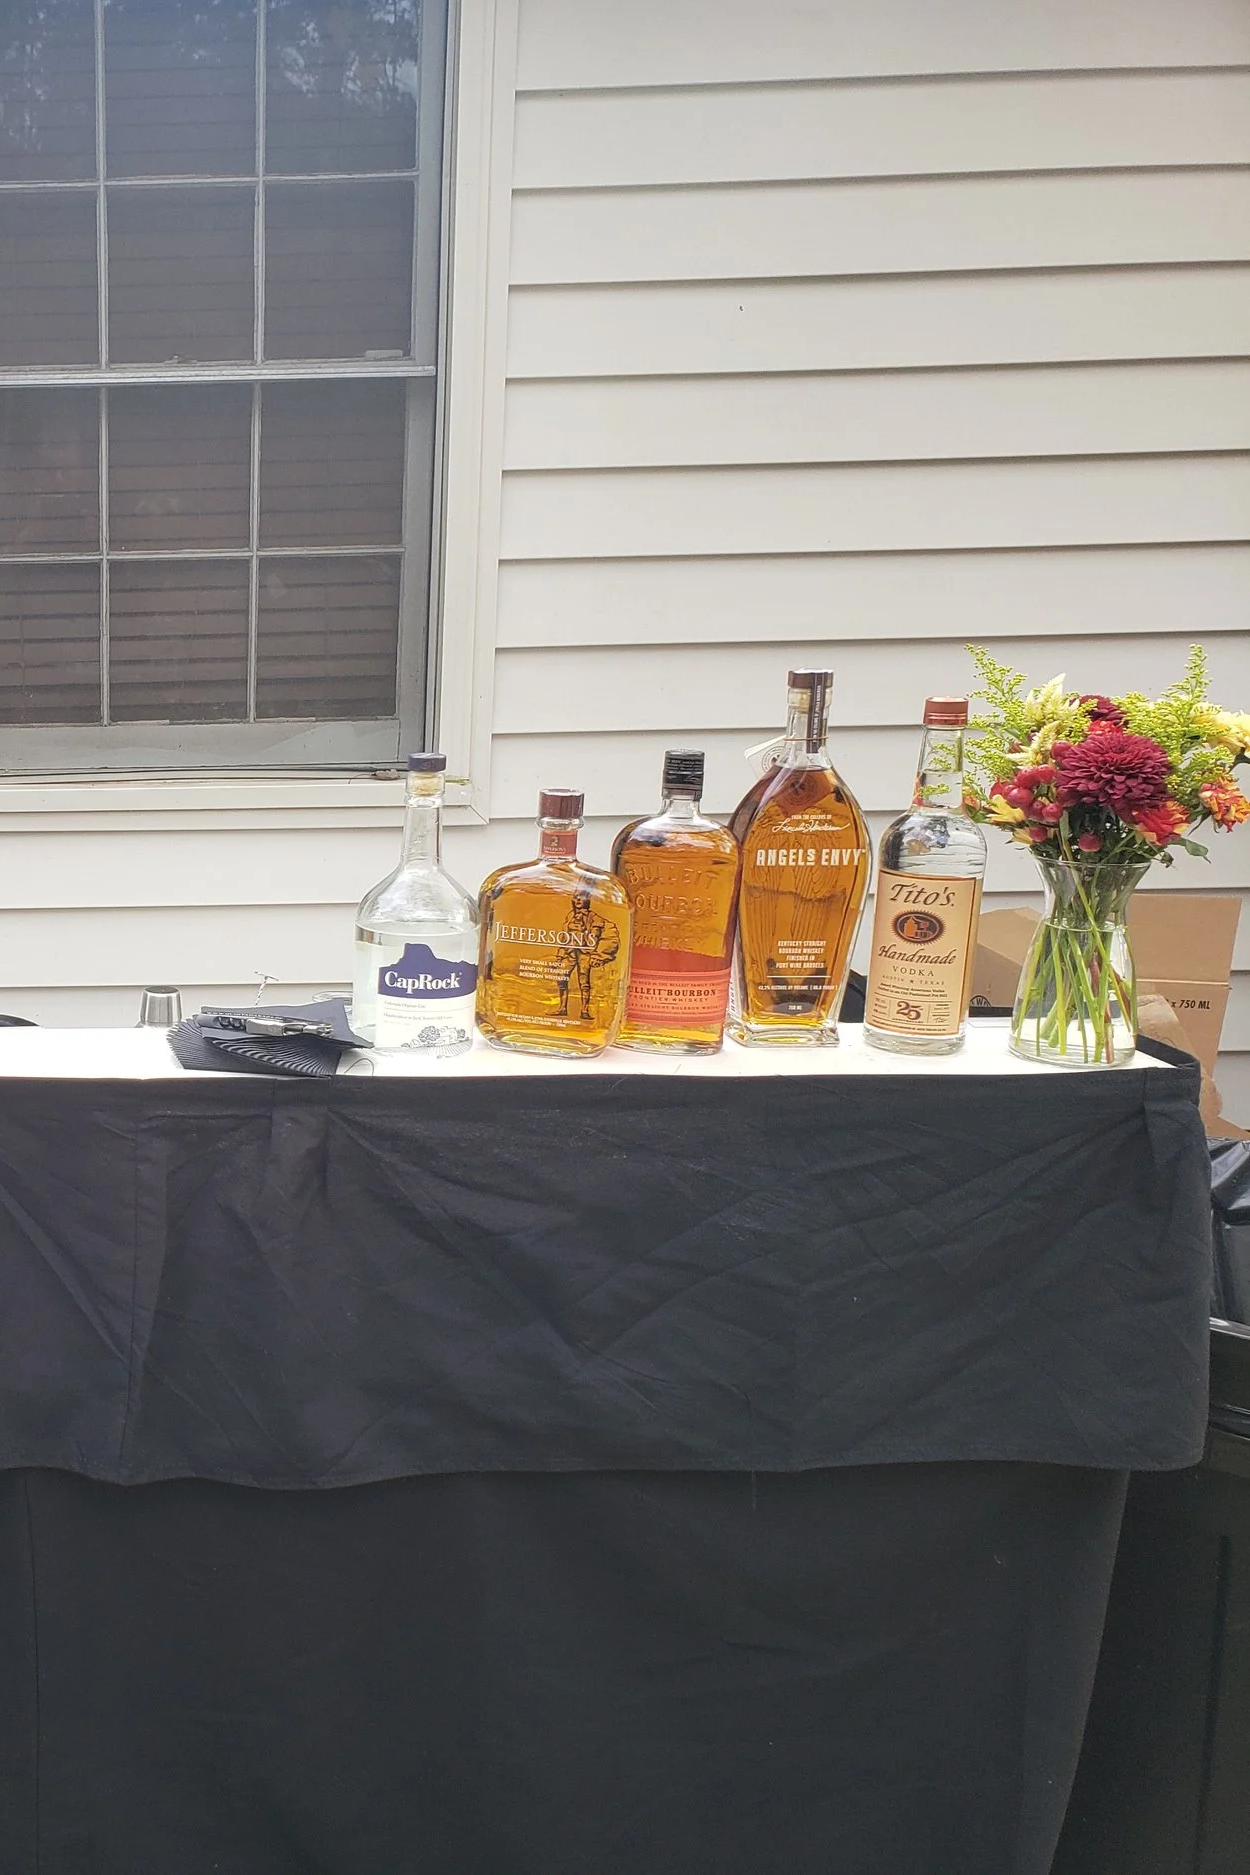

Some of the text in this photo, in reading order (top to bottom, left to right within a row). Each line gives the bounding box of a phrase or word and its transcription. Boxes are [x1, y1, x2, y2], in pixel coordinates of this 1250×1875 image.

[821, 848, 862, 866] ENVY
[494, 922, 597, 947] JEFFERSON'S
[878, 944, 957, 965] Handmade
[892, 965, 934, 977] VODKA
[384, 971, 461, 994] CapRock
[667, 989, 717, 997] BOURBON
[896, 1000, 922, 1021] 25
[1179, 1000, 1196, 1009] 750
[1198, 1000, 1211, 1010] ML
